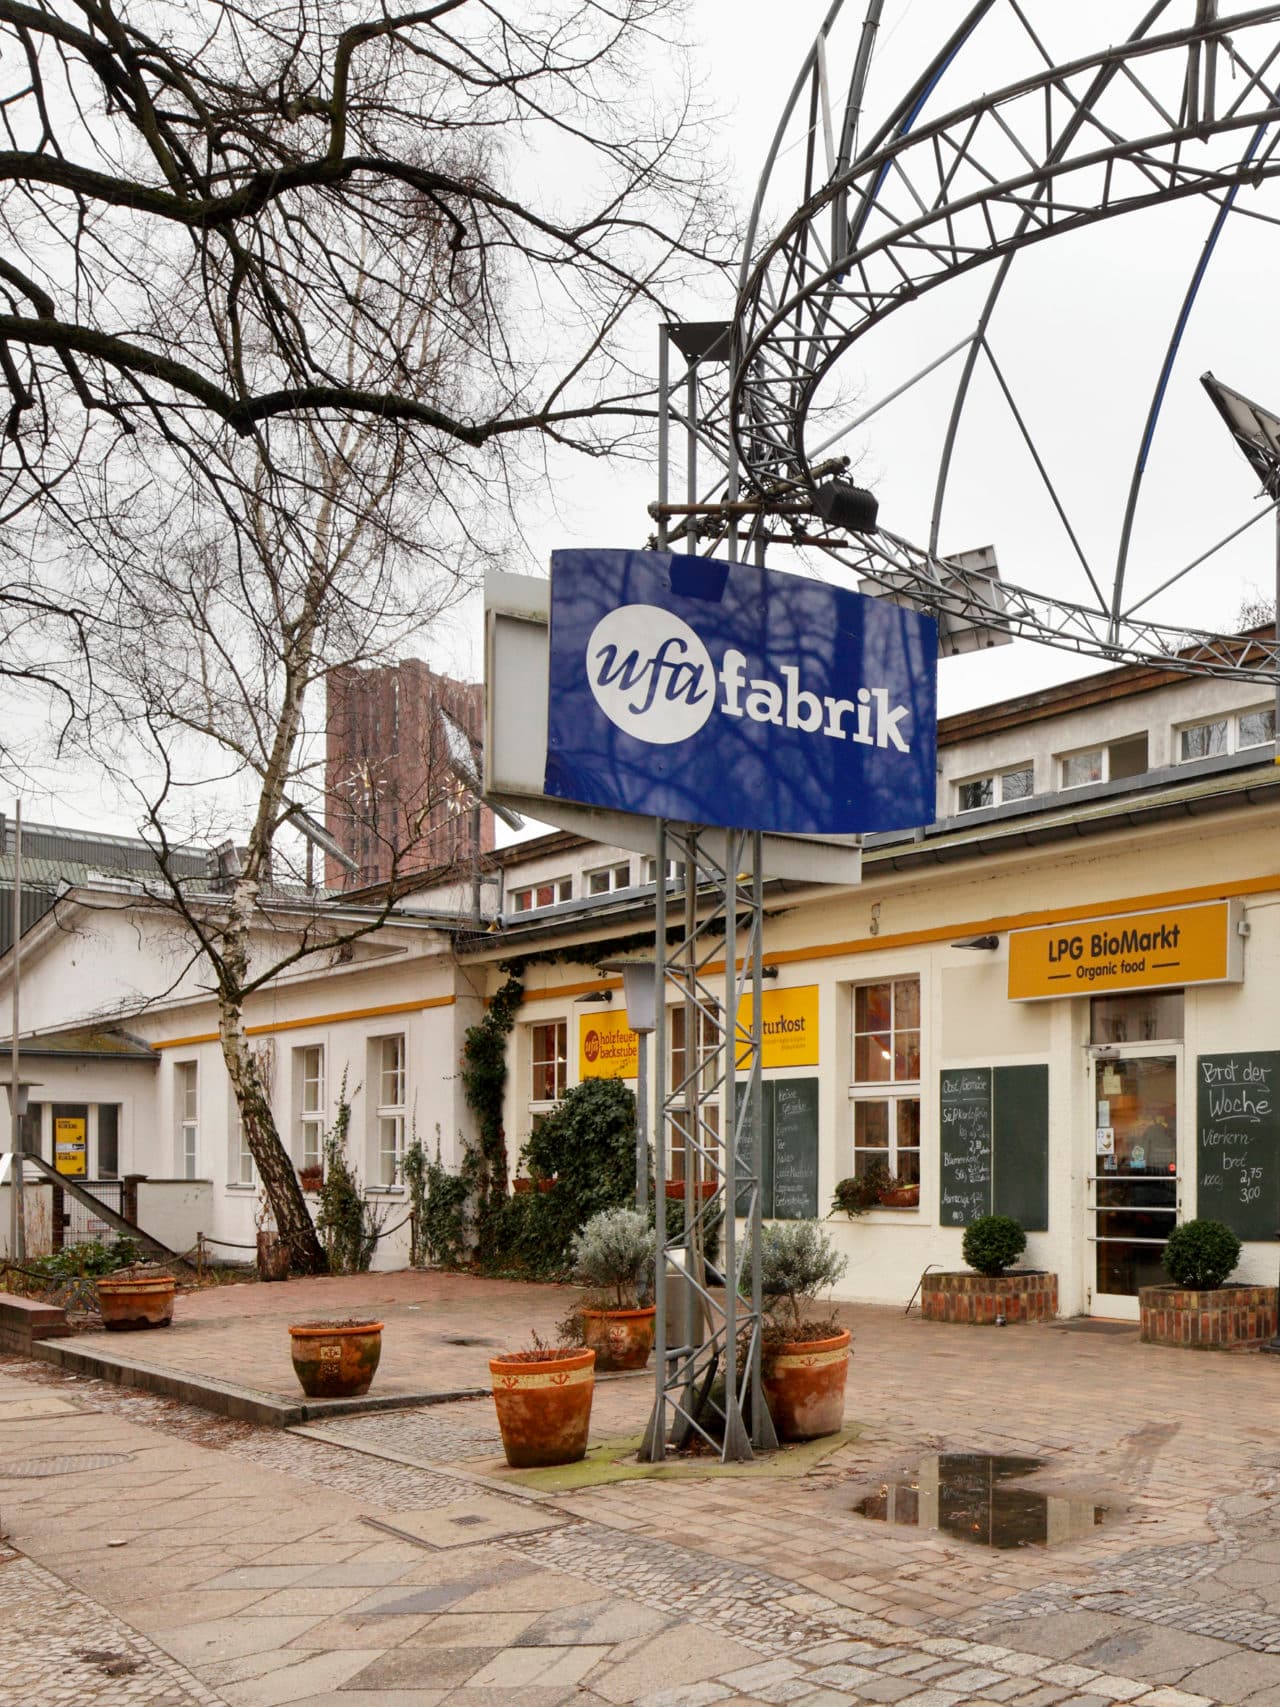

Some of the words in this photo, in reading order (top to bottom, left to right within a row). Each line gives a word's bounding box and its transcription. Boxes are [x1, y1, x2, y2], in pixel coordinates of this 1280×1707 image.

[719, 648, 911, 753] fabrik
[1048, 936, 1084, 962] LPG
[1091, 924, 1180, 958] BioMarkt
[1076, 963, 1117, 980] Organic
[1120, 959, 1146, 974] food
[600, 1030, 637, 1045] holzfeuer
[600, 1043, 638, 1059] backstube
[1202, 1060, 1238, 1083] Brot
[1242, 1061, 1273, 1082] der
[1209, 1088, 1273, 1117] Woche
[1222, 1152, 1248, 1170] brot
[1240, 1168, 1263, 1186] 2,75
[1240, 1186, 1261, 1204] 3,00
